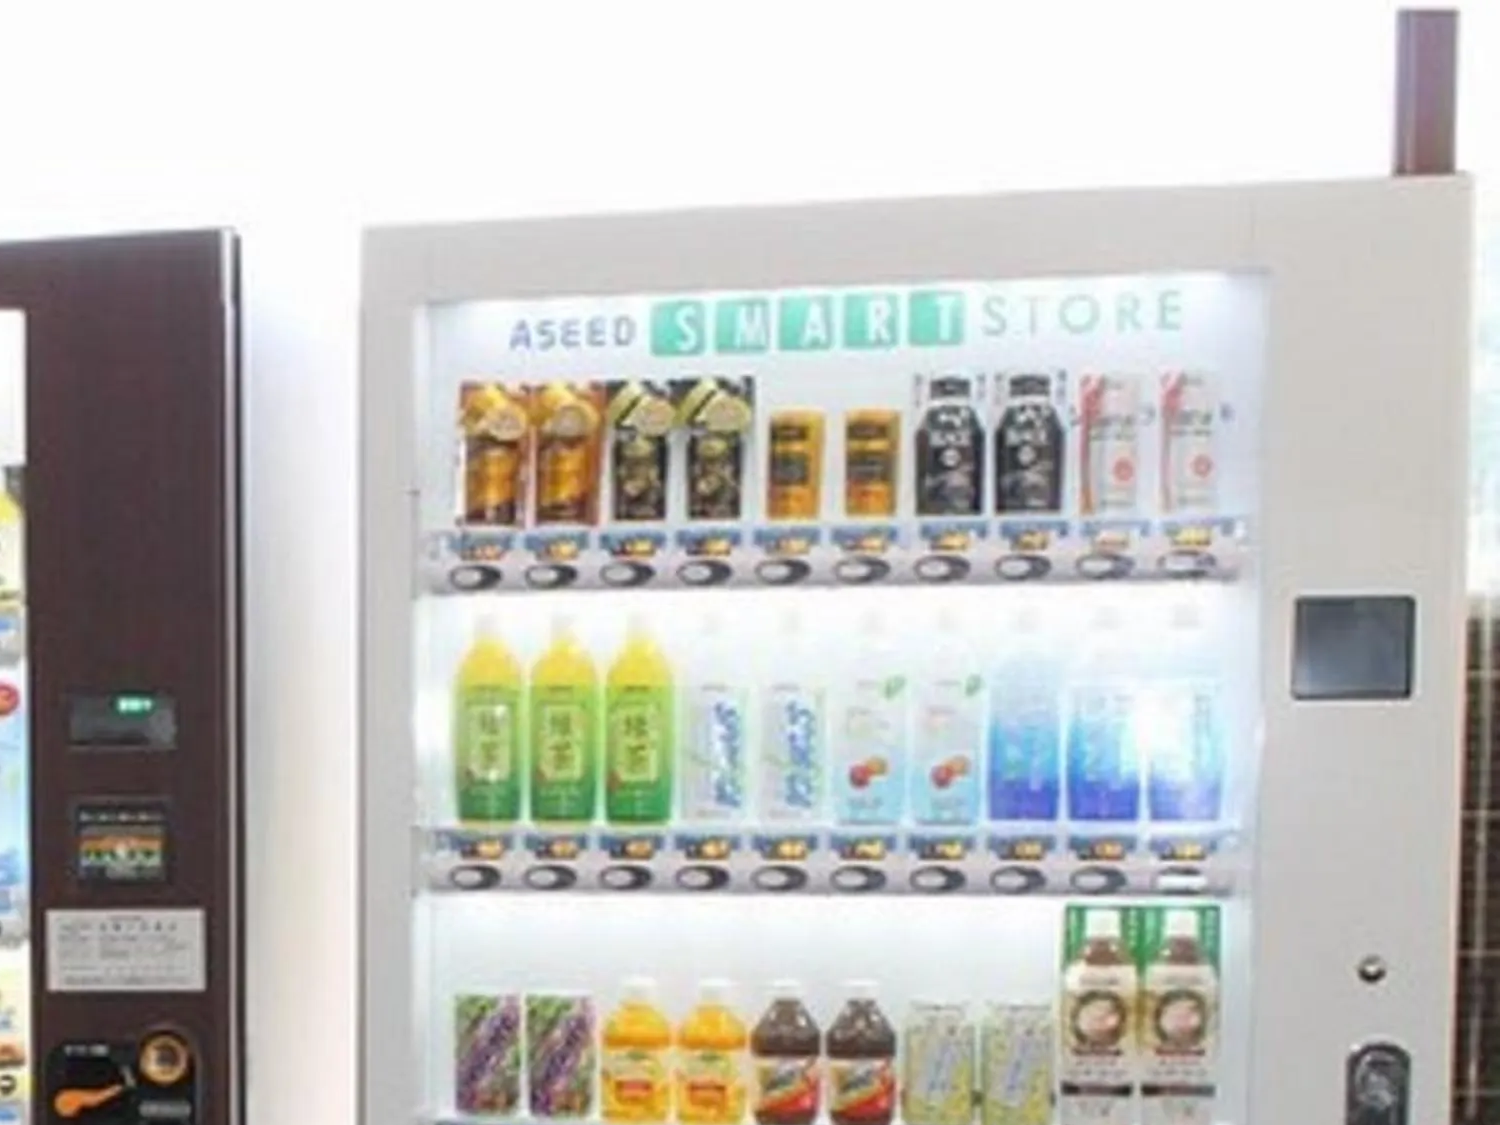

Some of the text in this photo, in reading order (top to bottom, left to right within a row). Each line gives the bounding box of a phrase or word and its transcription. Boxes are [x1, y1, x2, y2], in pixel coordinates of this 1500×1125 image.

[509, 289, 1184, 352] ASEED SMART STORE
